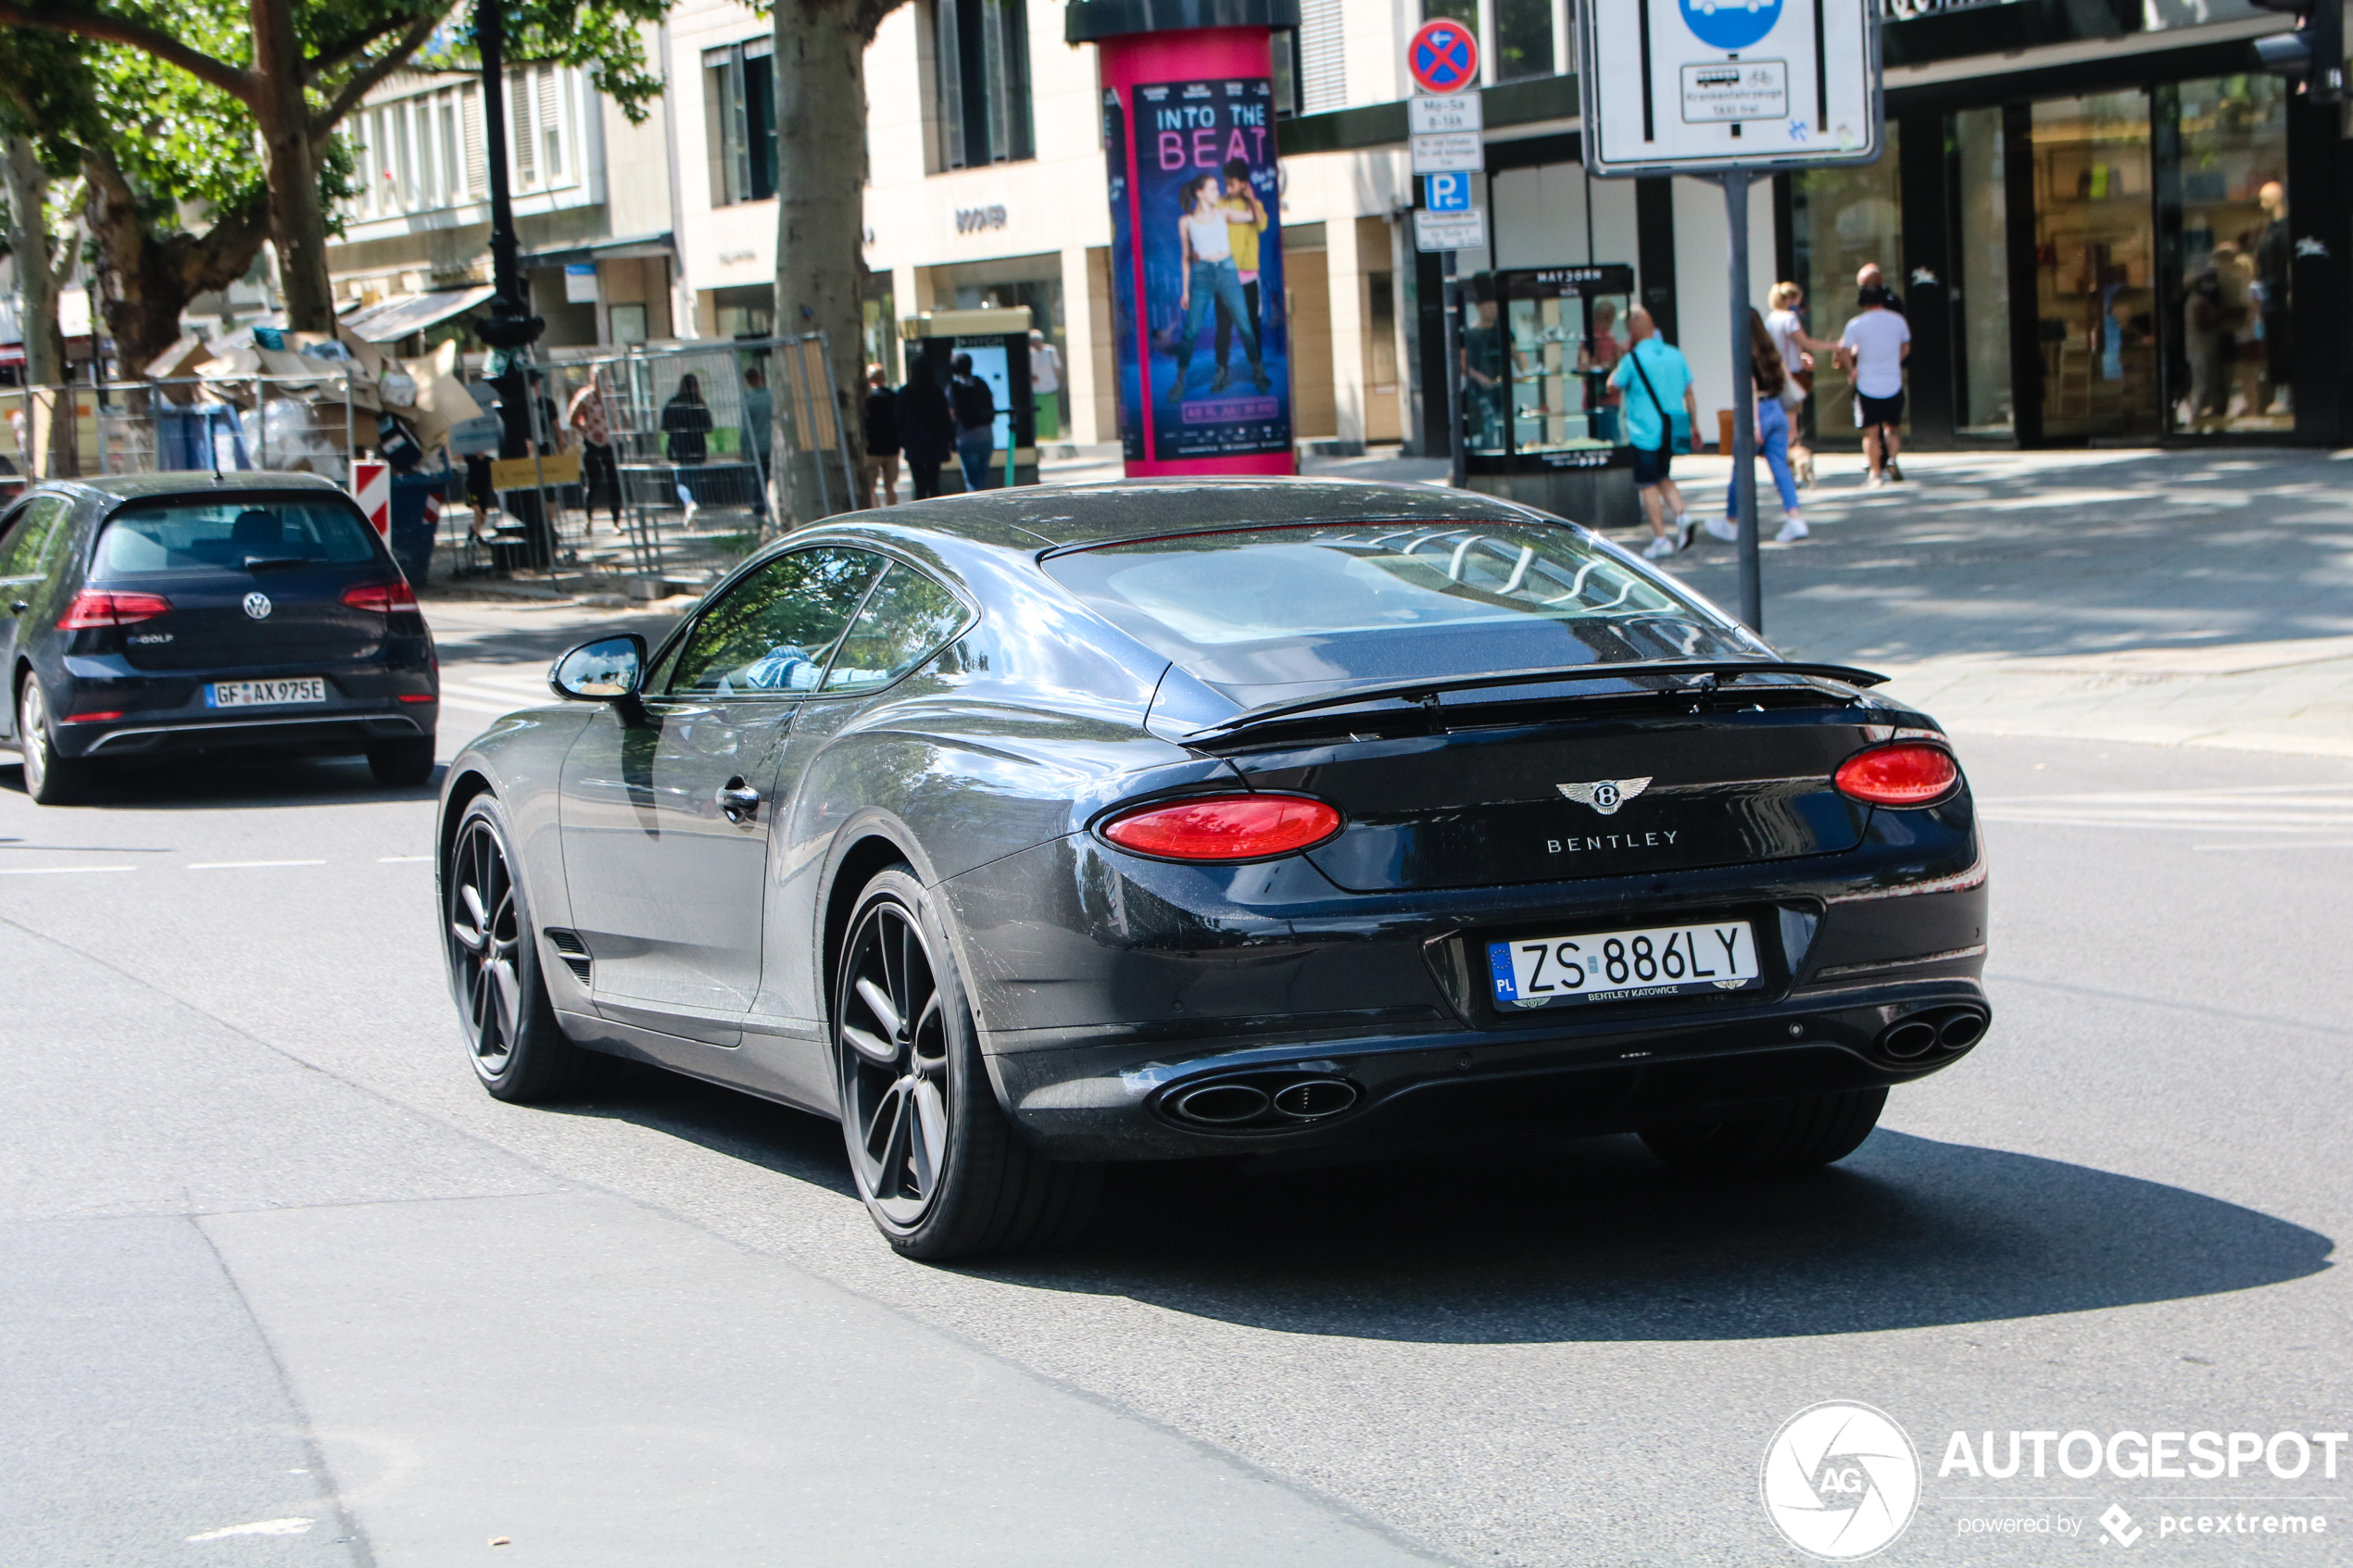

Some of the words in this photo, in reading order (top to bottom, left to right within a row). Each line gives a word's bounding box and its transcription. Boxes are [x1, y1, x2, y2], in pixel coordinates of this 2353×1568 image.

[1157, 106, 1215, 131] INTO
[1229, 103, 1265, 126] THE
[1159, 126, 1266, 170] BEAT
[1432, 174, 1457, 207] P
[217, 684, 238, 705] GF
[255, 682, 275, 703] AX
[280, 680, 322, 701] 975E
[1547, 830, 1677, 854] BENTLEY
[1522, 942, 1585, 993] ZS
[1603, 928, 1738, 985] 886LY
[1496, 979, 1514, 993] PL
[1588, 990, 1629, 1001] BENTLEY
[1631, 985, 1678, 997] KATOWICE
